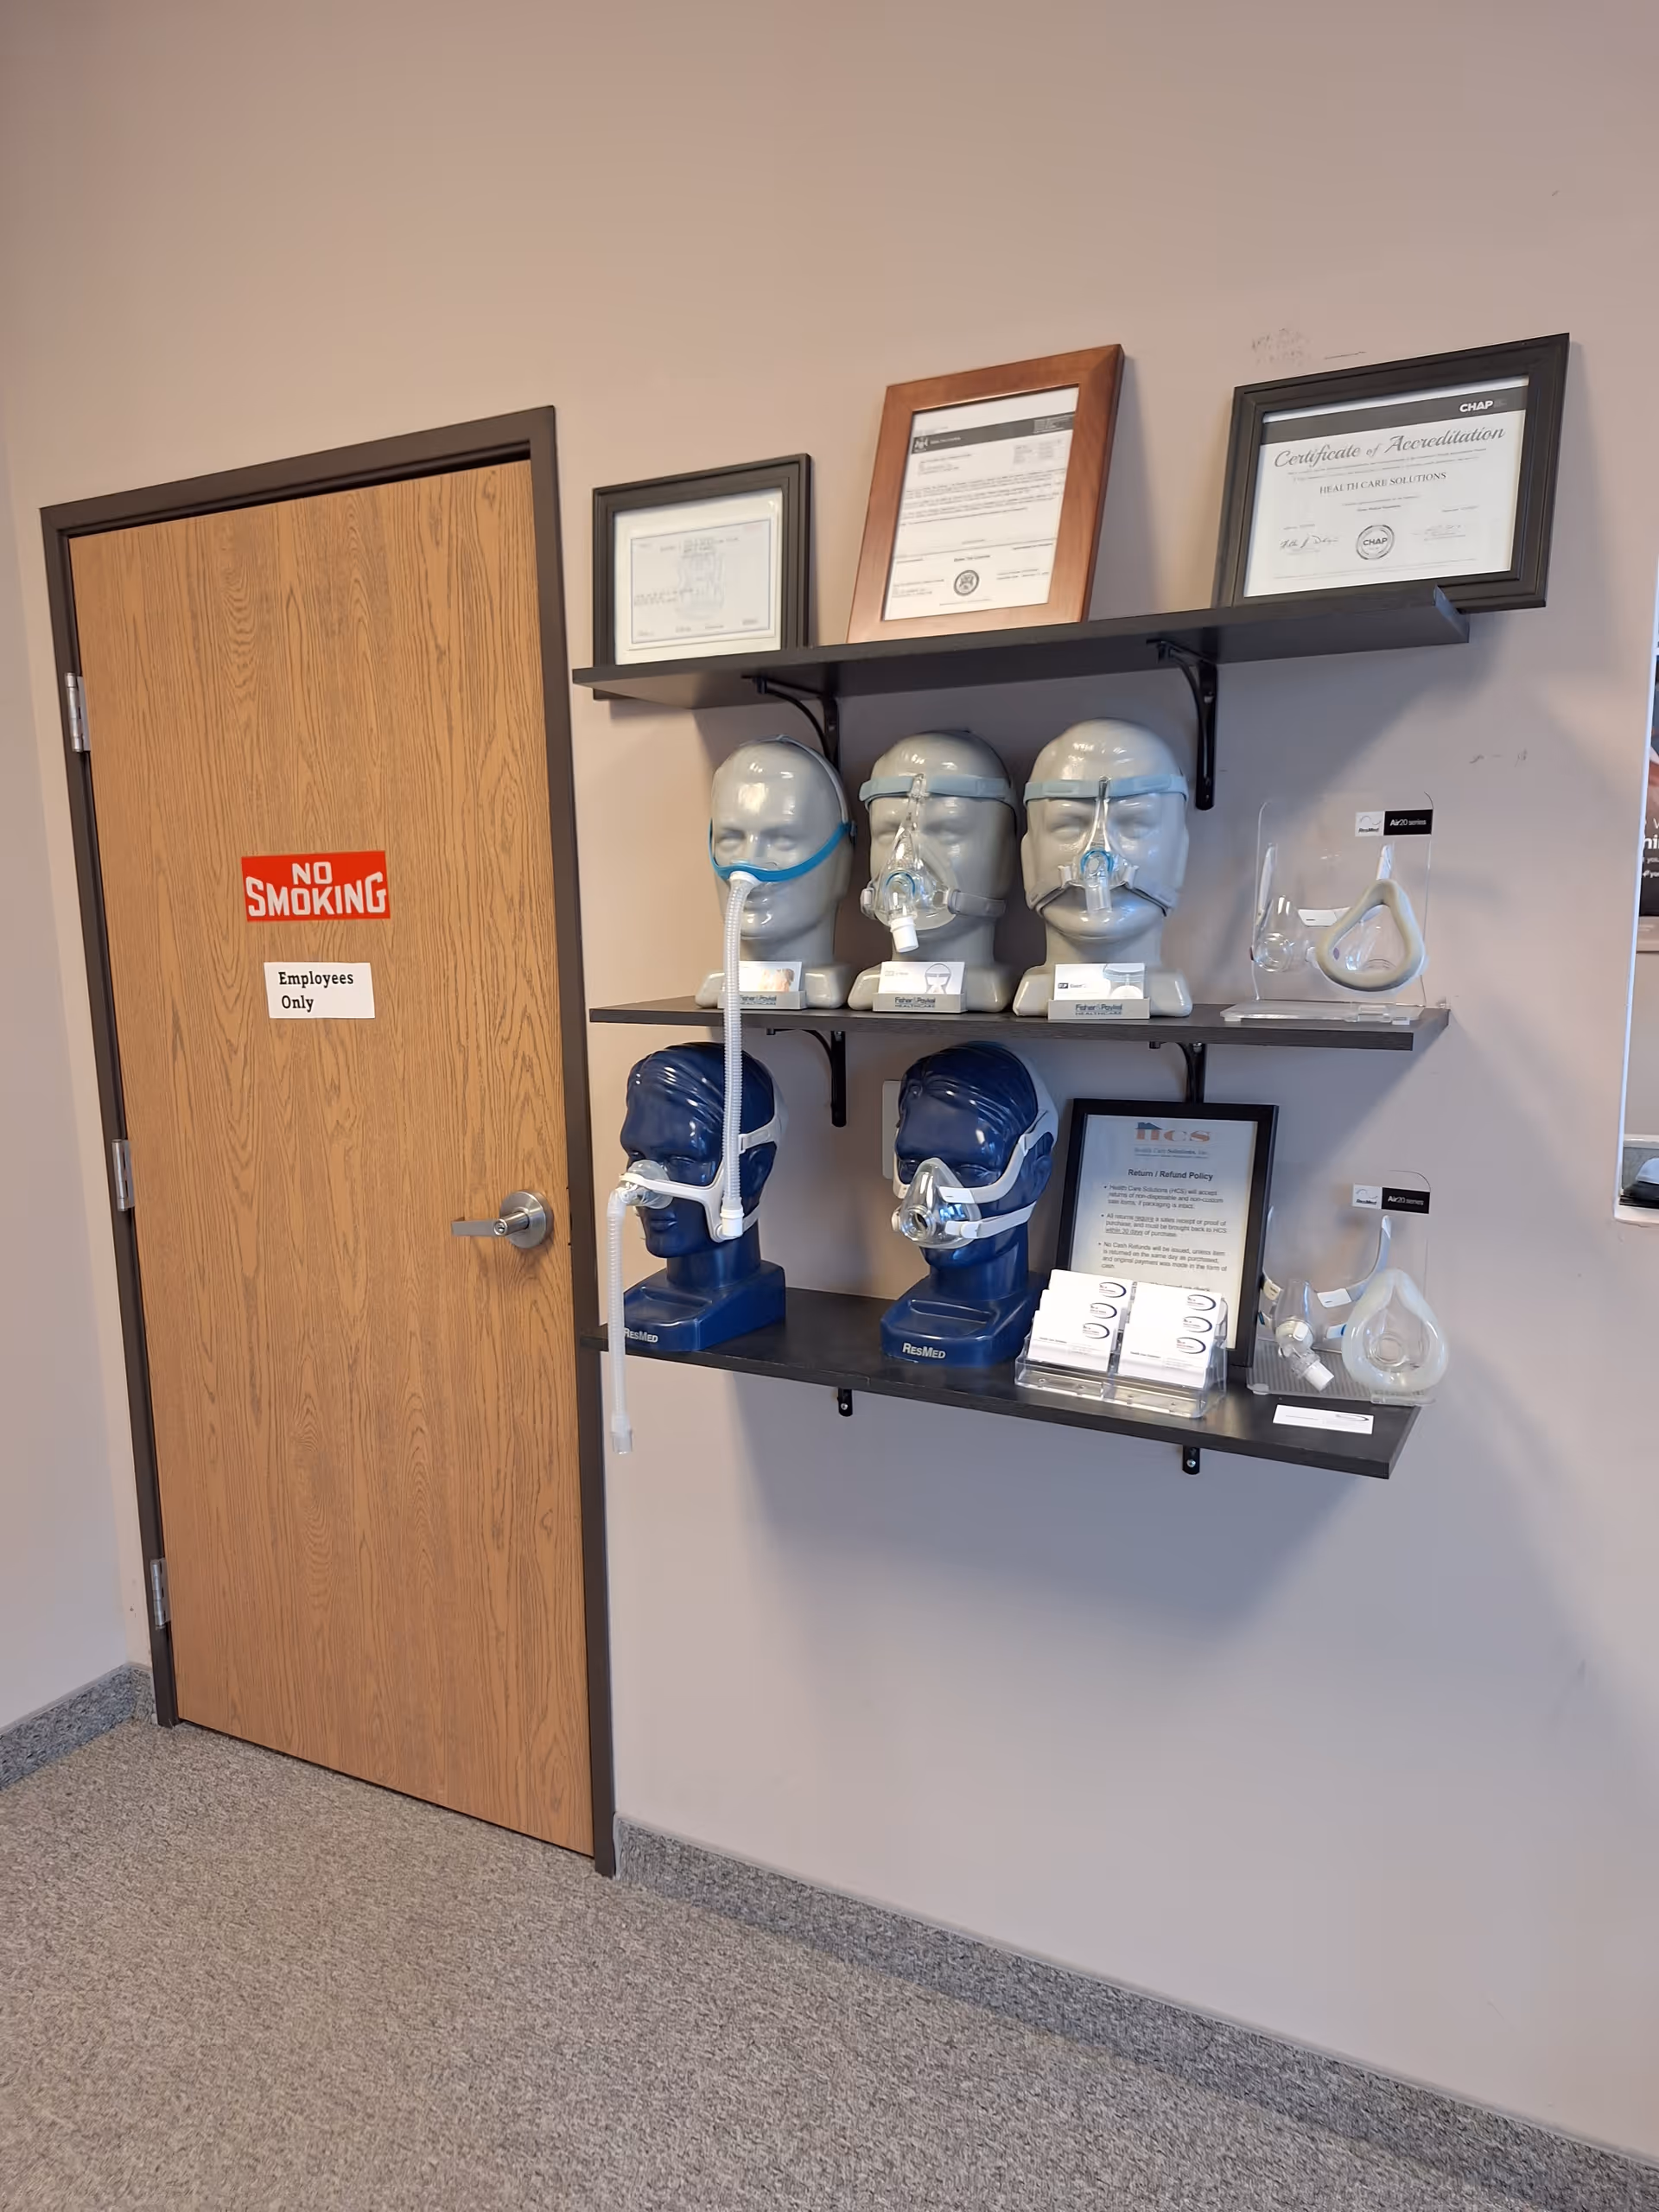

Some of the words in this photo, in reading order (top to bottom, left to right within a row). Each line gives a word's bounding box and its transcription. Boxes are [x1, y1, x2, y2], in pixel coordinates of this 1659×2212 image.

[1459, 400, 1493, 413] CHAP
[1274, 444, 1360, 467] Certificate
[1366, 443, 1382, 459] of
[1384, 427, 1505, 454] Accreditation
[1319, 480, 1359, 494] HEALTH
[1361, 477, 1388, 489] CARE
[1389, 472, 1446, 486] SOLUTIONS
[1363, 537, 1389, 547] CHAP
[291, 861, 333, 886] NO
[245, 871, 386, 917] SMOKING
[278, 971, 354, 988] Employees
[281, 995, 315, 1013] Only
[1128, 1168, 1154, 1178] Return
[1160, 1170, 1187, 1179] Refund
[1188, 1171, 1214, 1181] Policy
